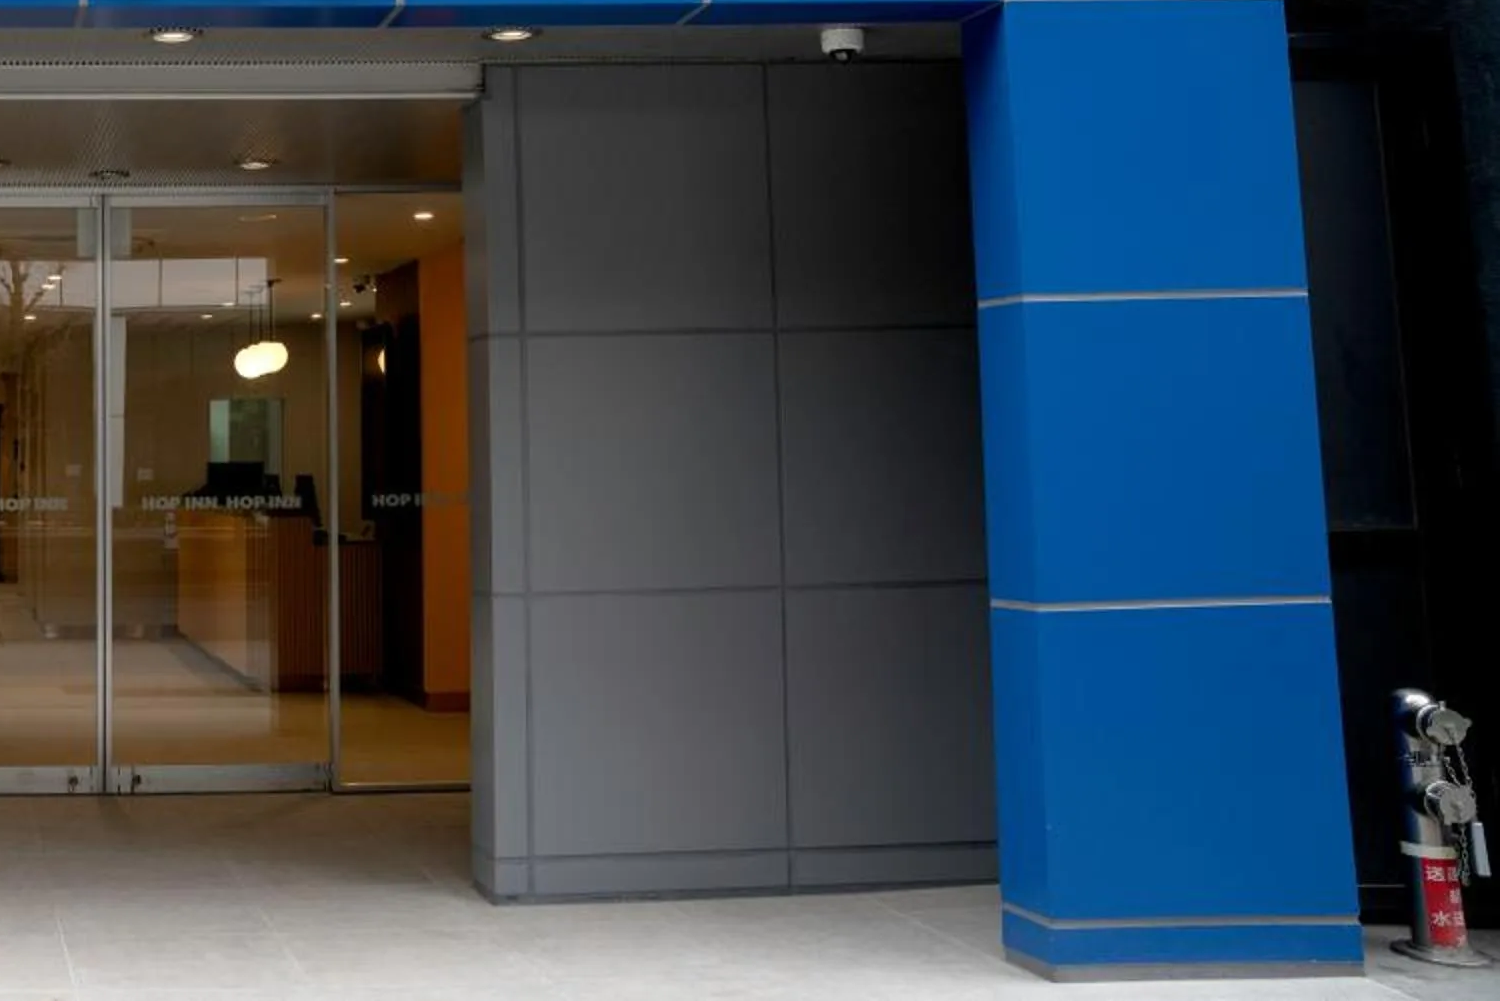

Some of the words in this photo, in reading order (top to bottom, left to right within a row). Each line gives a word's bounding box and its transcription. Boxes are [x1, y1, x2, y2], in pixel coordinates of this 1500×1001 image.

[142, 495, 181, 510] HOP
[184, 495, 219, 510] INN
[226, 495, 265, 509] HOP
[268, 495, 303, 509] INN
[371, 493, 412, 508] HOP
